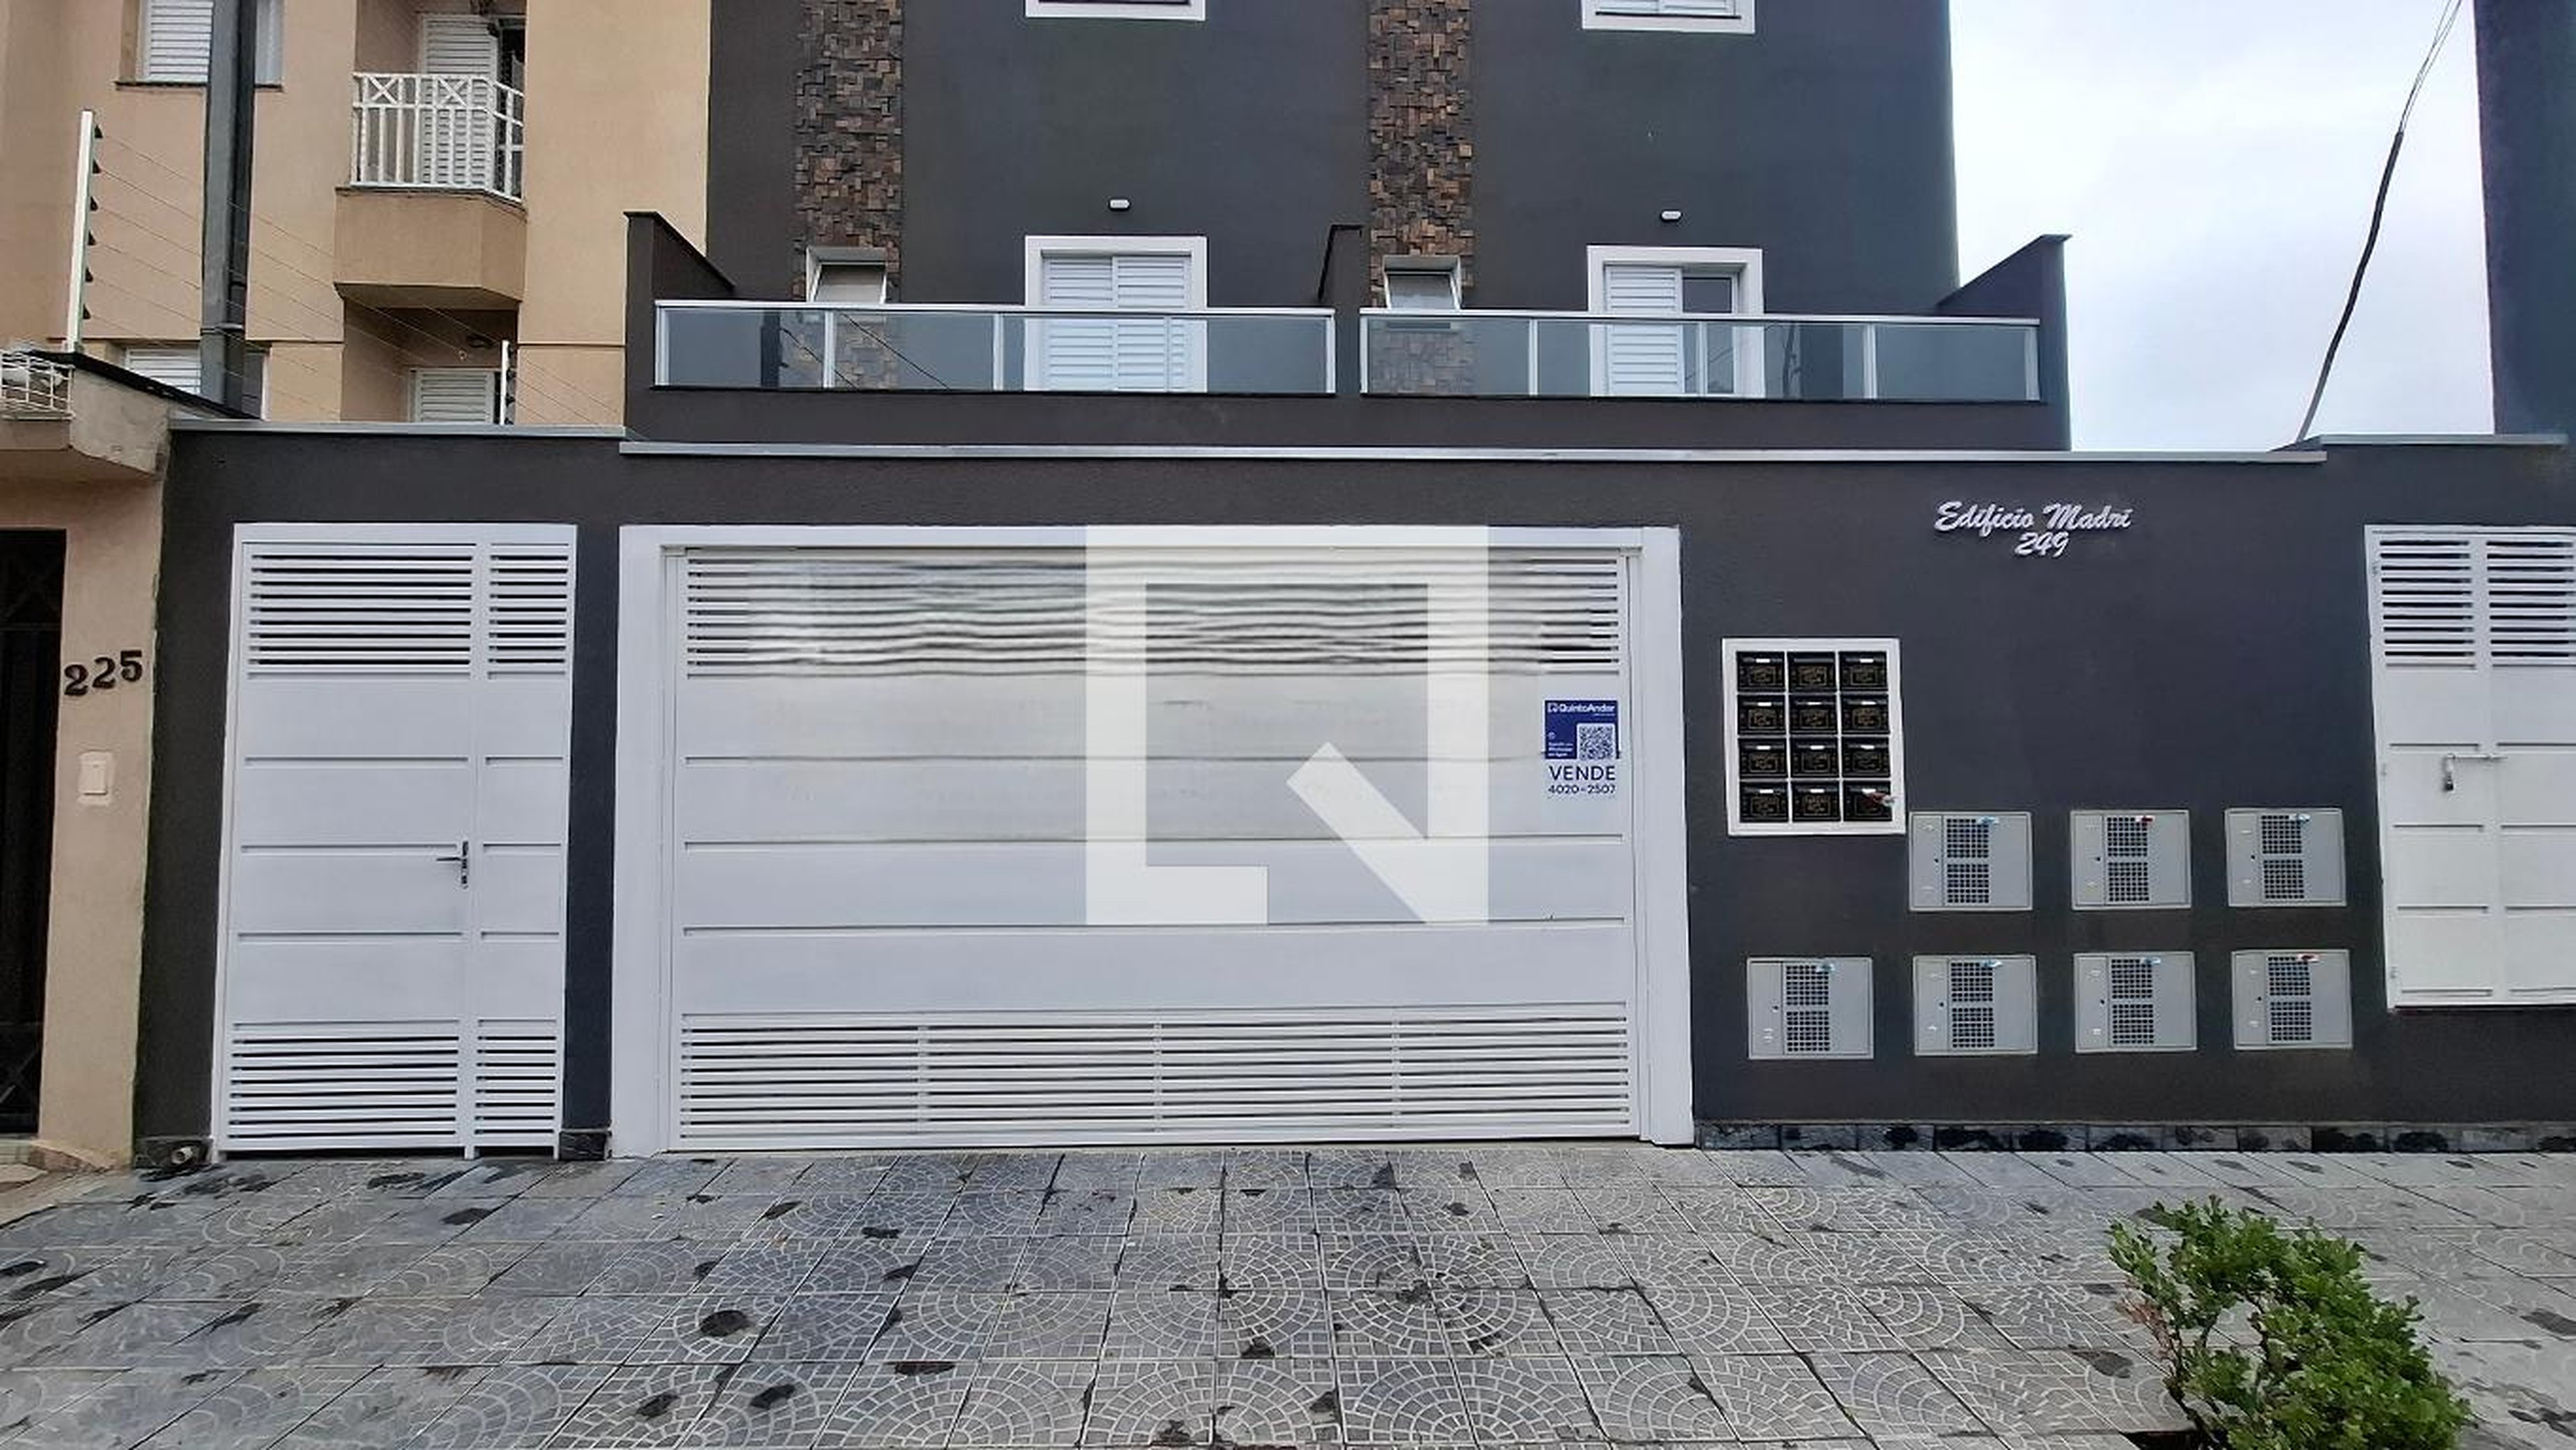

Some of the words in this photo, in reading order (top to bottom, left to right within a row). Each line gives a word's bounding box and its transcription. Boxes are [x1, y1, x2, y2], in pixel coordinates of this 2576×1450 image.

[1934, 501, 2034, 537] Edificio
[2043, 504, 2133, 529] Madri
[2015, 532, 2069, 557] 249
[64, 650, 143, 696] 225
[1559, 704, 1615, 713] QuintoAndar
[1548, 766, 1615, 781] VENDE
